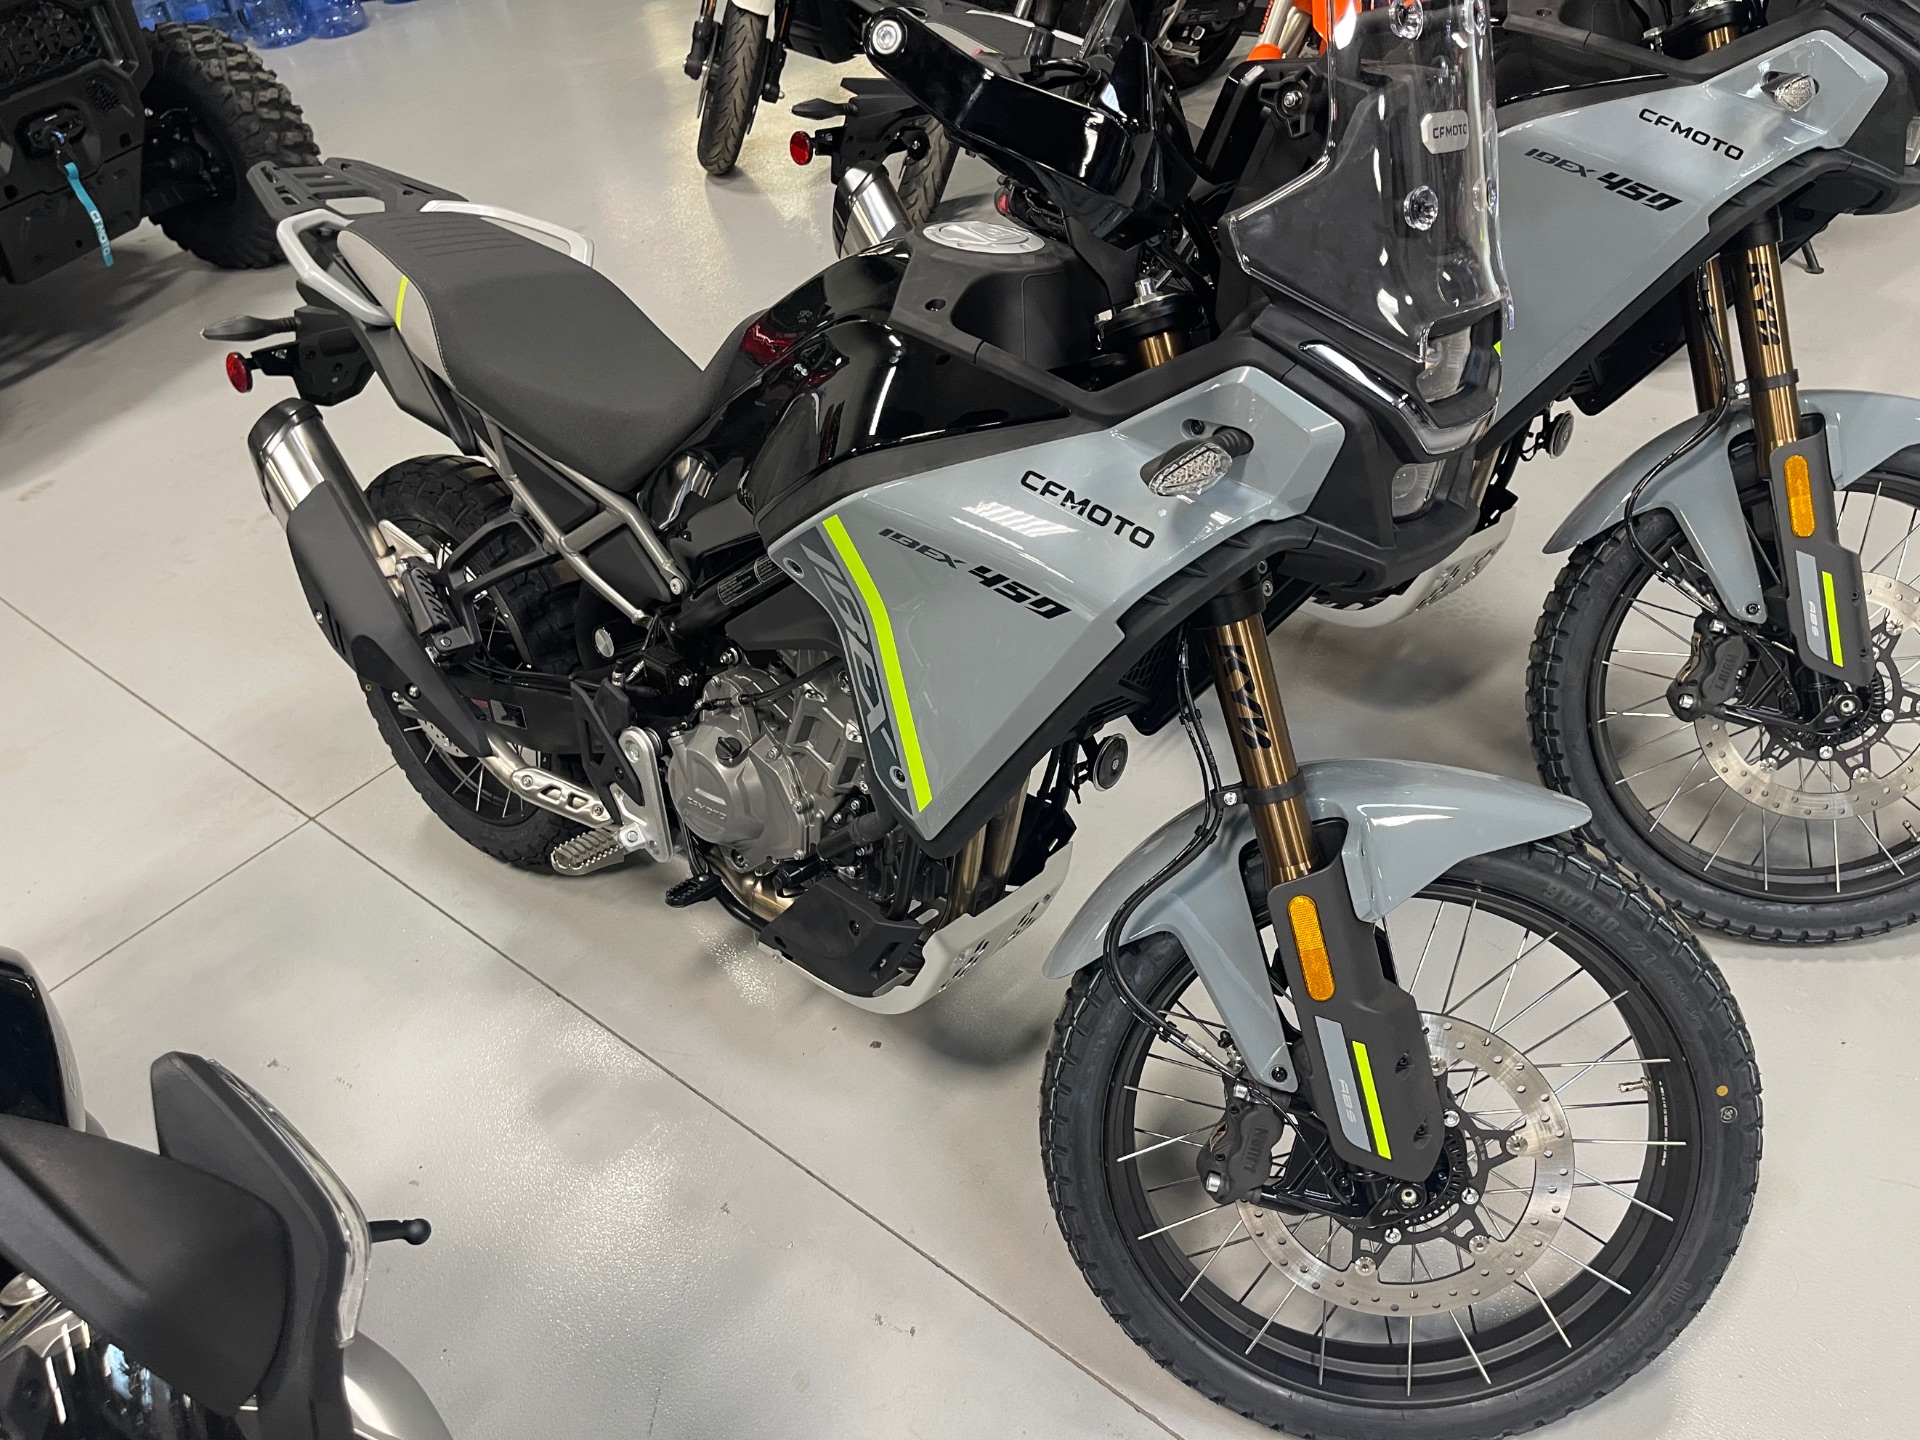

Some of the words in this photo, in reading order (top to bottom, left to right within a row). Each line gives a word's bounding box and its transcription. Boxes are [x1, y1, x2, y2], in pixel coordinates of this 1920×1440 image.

[1432, 123, 1468, 139] CFMOTO
[1640, 108, 1744, 161] CFMOTO
[1524, 148, 1598, 178] IBEX
[1596, 171, 1683, 212] 450
[1020, 470, 1155, 549] CFMOTO
[878, 528, 967, 570] IBEX
[967, 565, 1072, 620] 450
[1808, 600, 1820, 638] ABS
[1338, 1078, 1357, 1124] ABS
